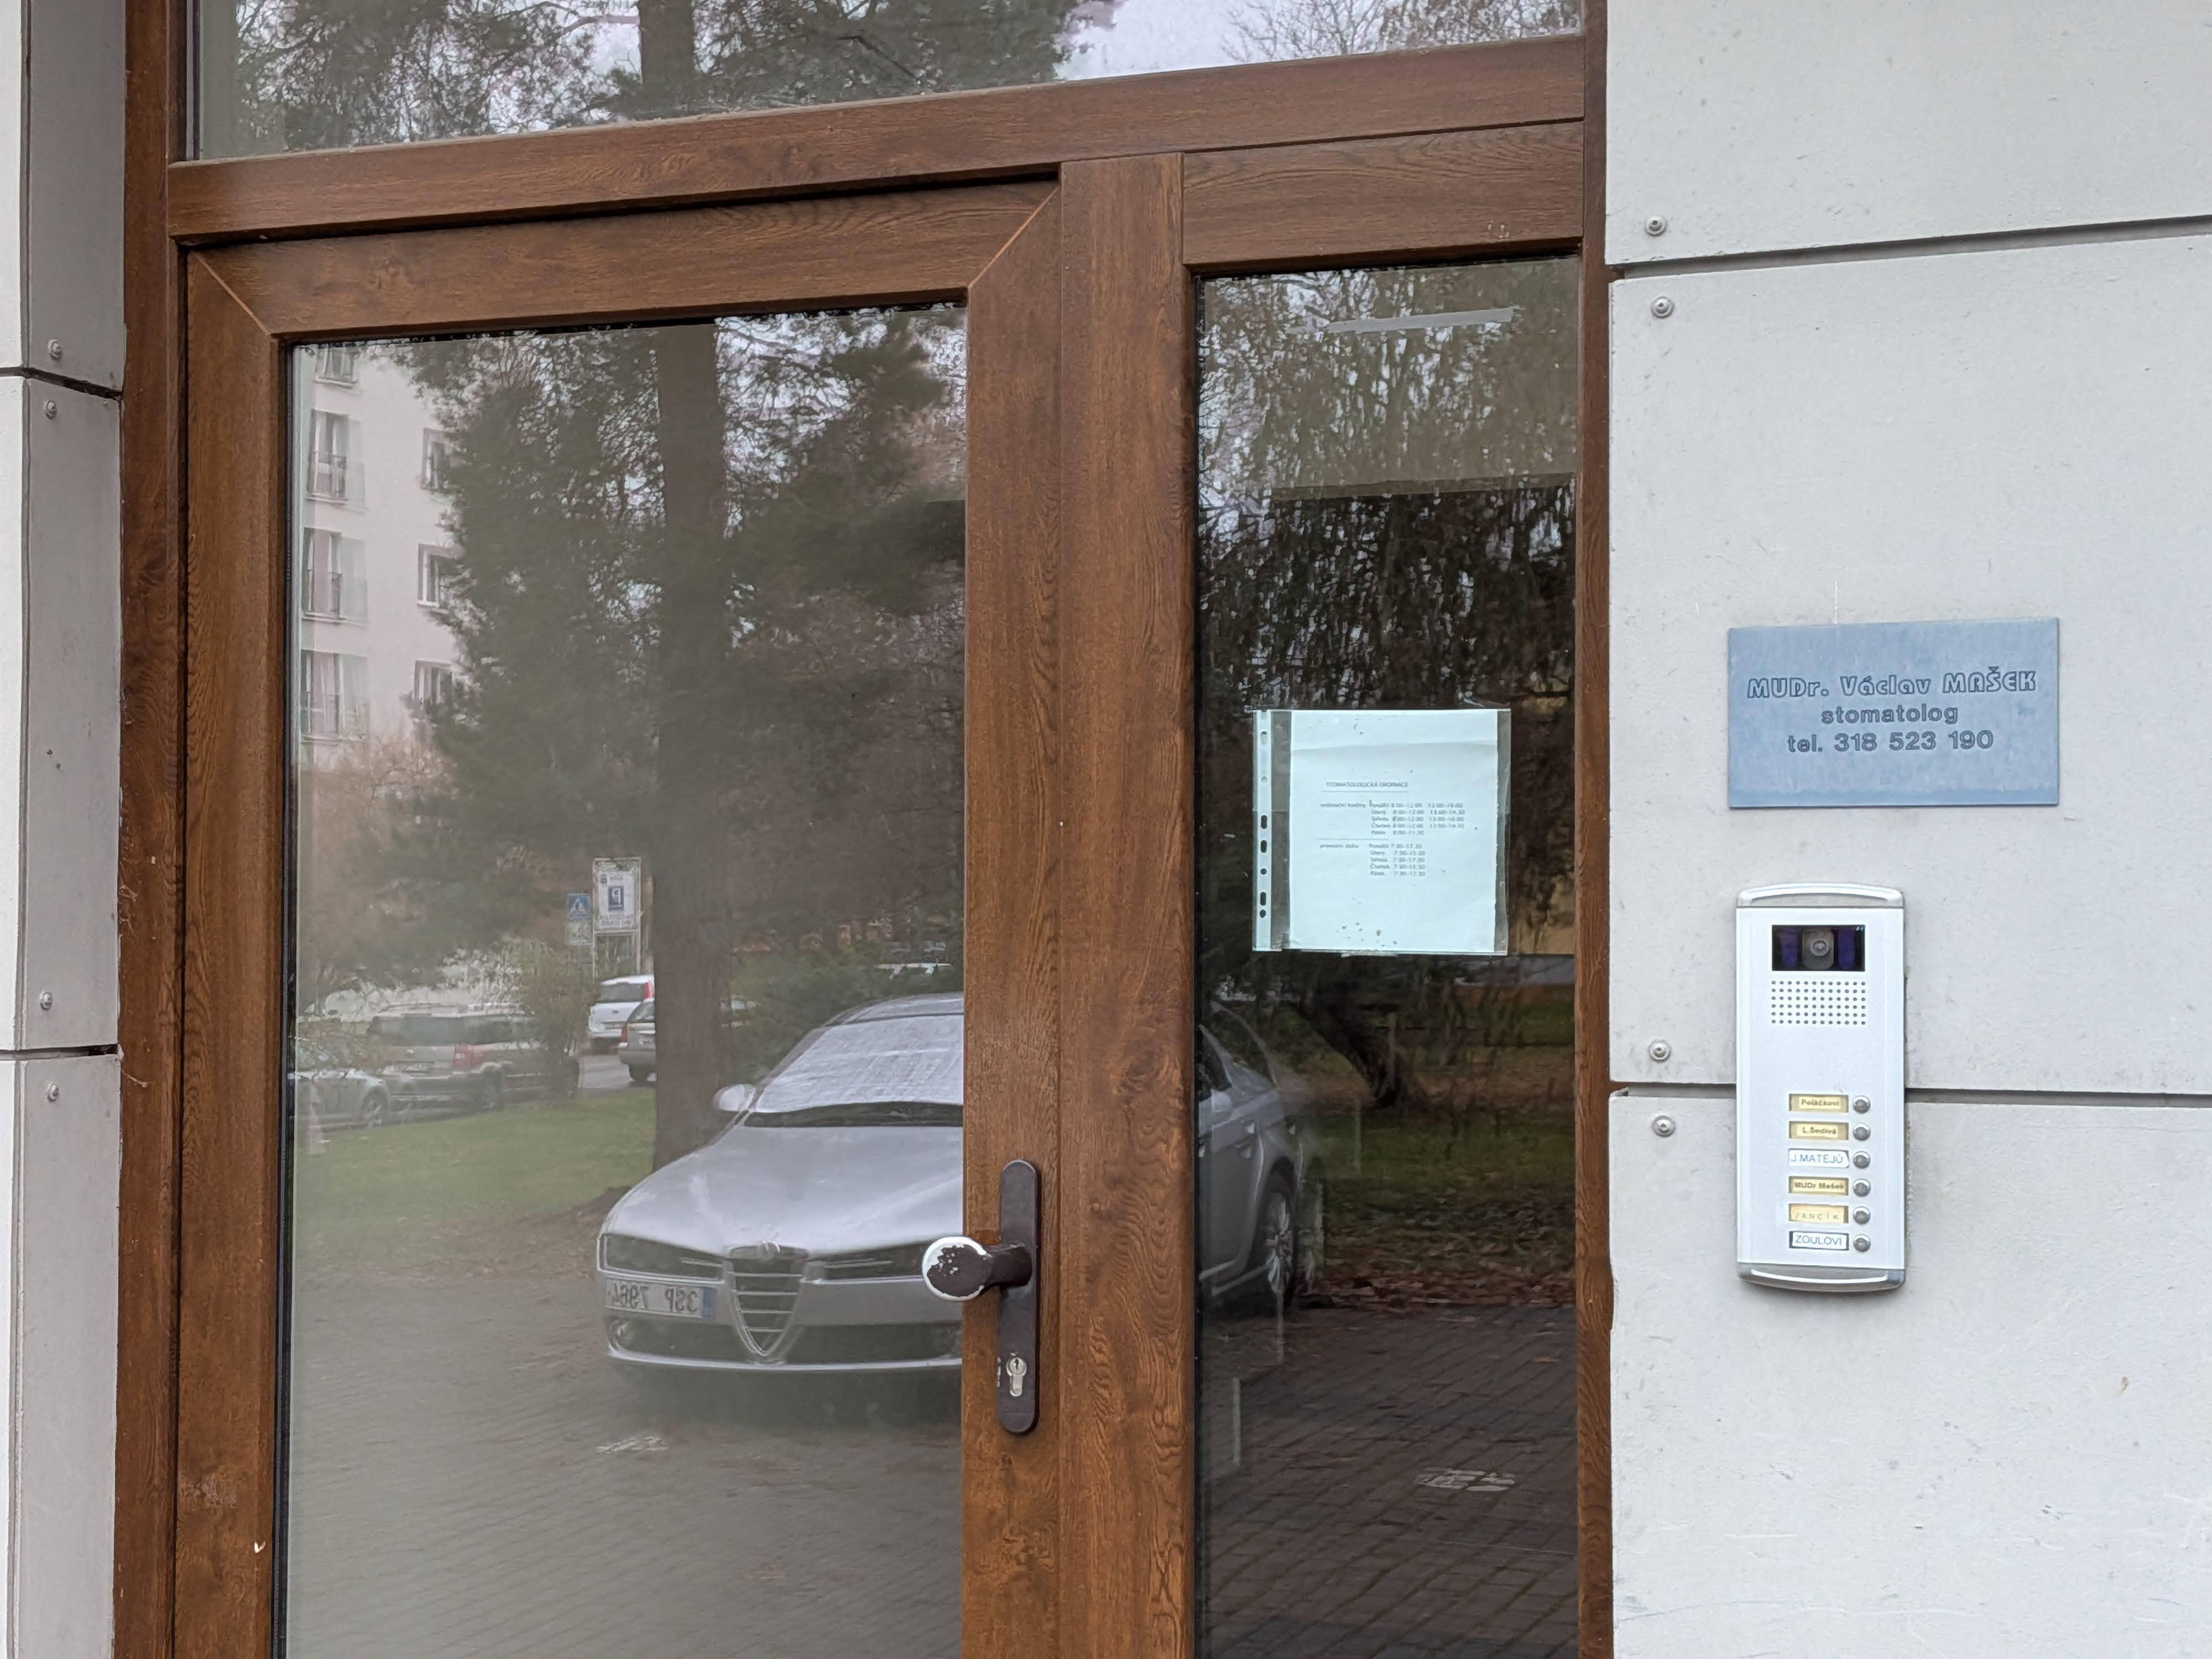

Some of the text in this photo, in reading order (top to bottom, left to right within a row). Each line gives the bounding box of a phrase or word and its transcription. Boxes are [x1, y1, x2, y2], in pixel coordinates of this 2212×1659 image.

[1747, 666, 2036, 698] MUDr. Václav MAŠEK
[1822, 704, 1959, 725] stomatolog
[1787, 730, 1994, 753] tel. 318 523 190
[1796, 1235, 1842, 1246] ZOULOVI
